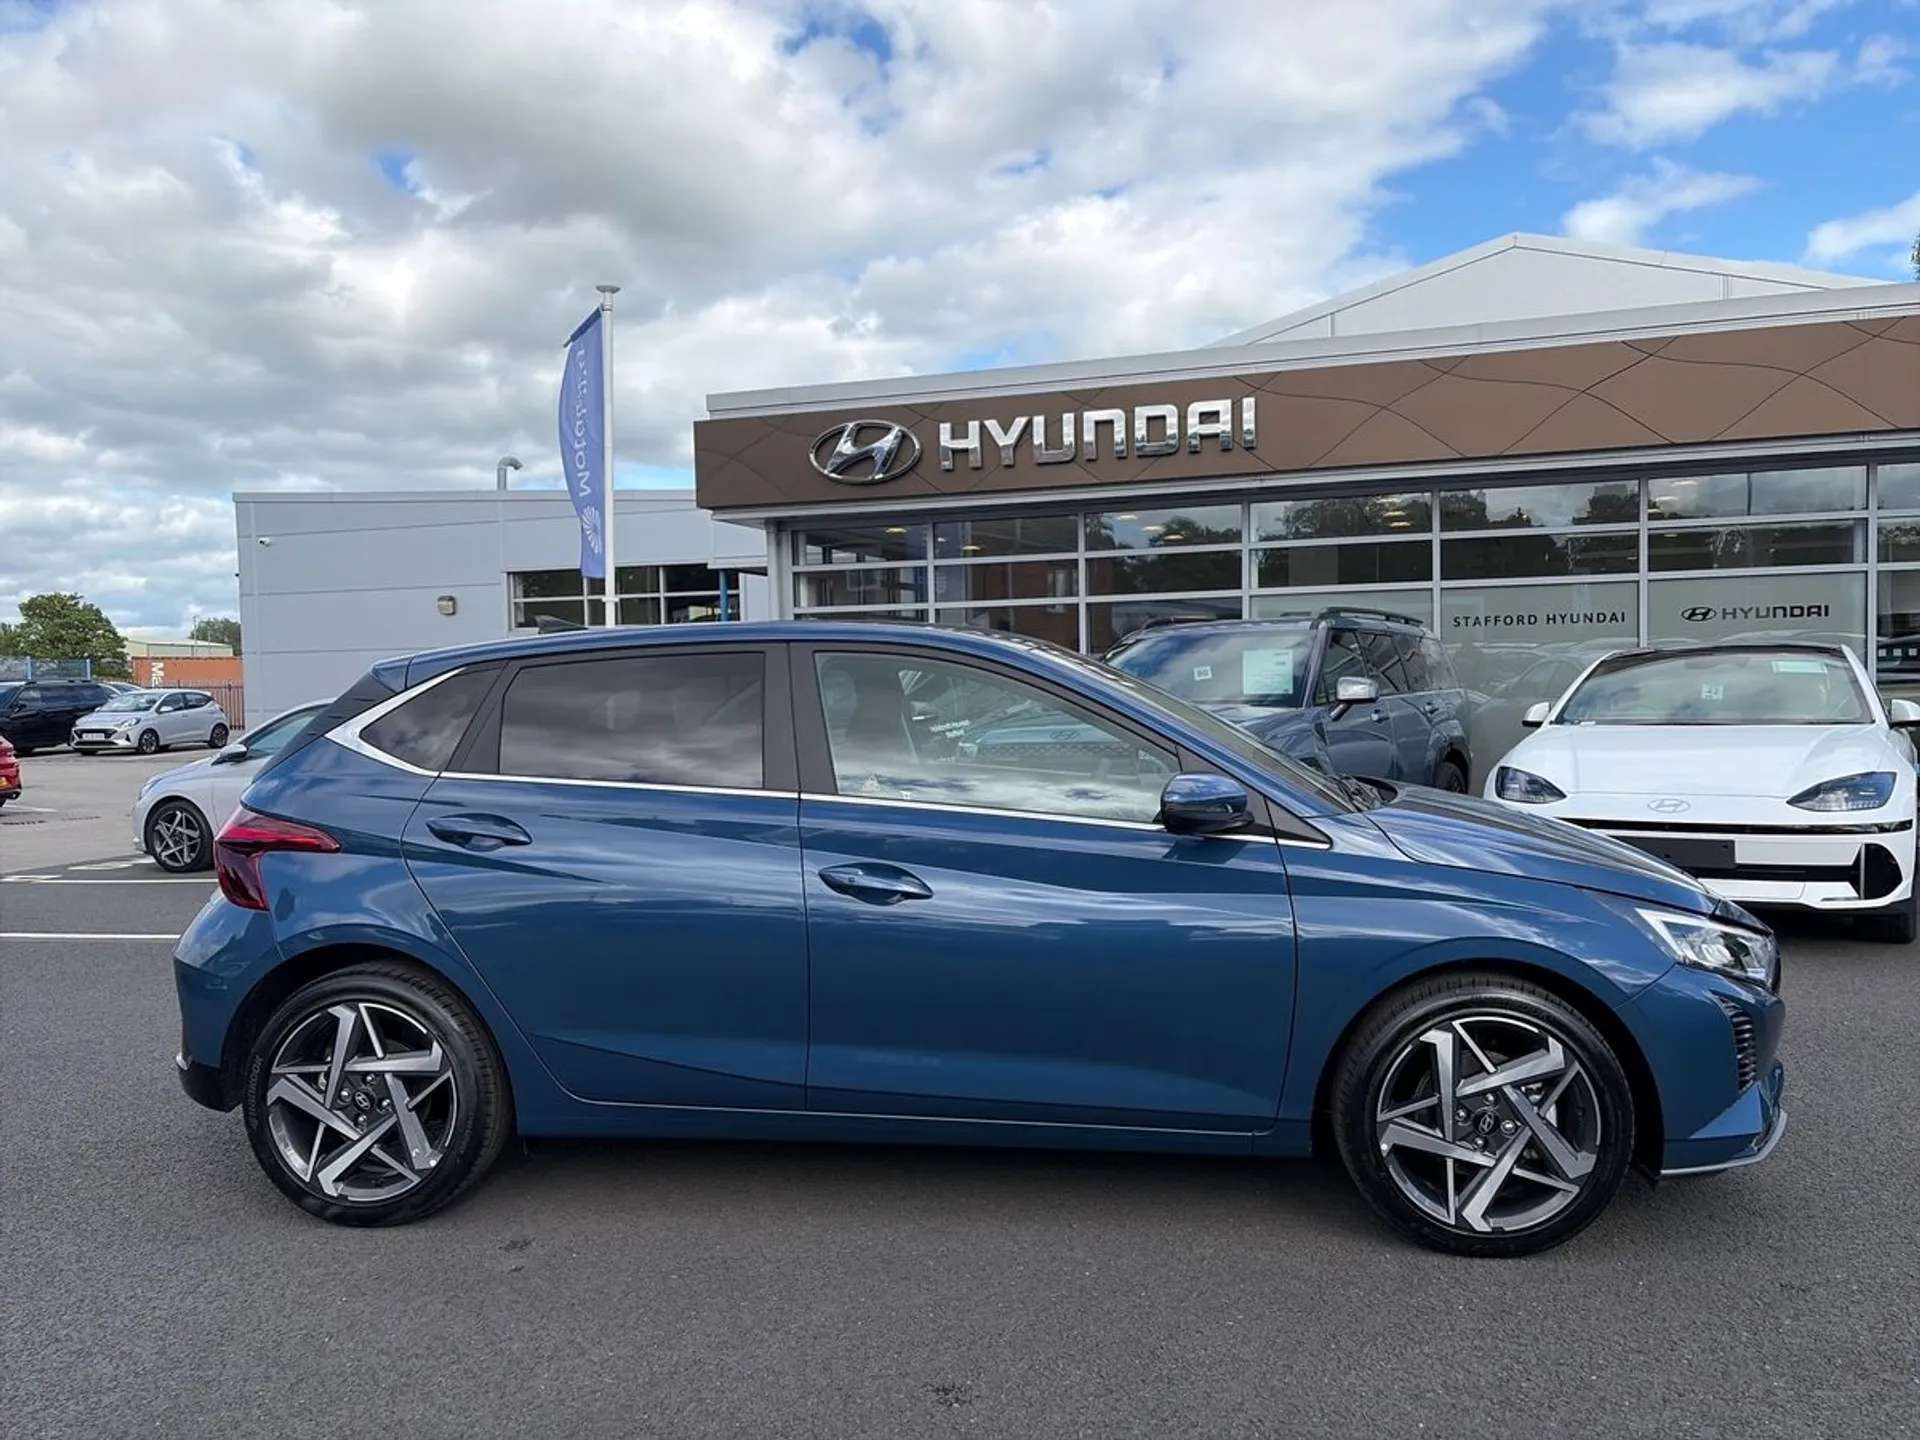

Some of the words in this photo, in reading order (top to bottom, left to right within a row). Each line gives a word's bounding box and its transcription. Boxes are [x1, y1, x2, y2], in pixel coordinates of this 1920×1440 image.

[938, 397, 1257, 471] HYUNDAI
[1453, 614, 1538, 628] STAFFORD
[1546, 611, 1626, 625] HYUNDAI
[1721, 604, 1829, 620] HYUNDAI
